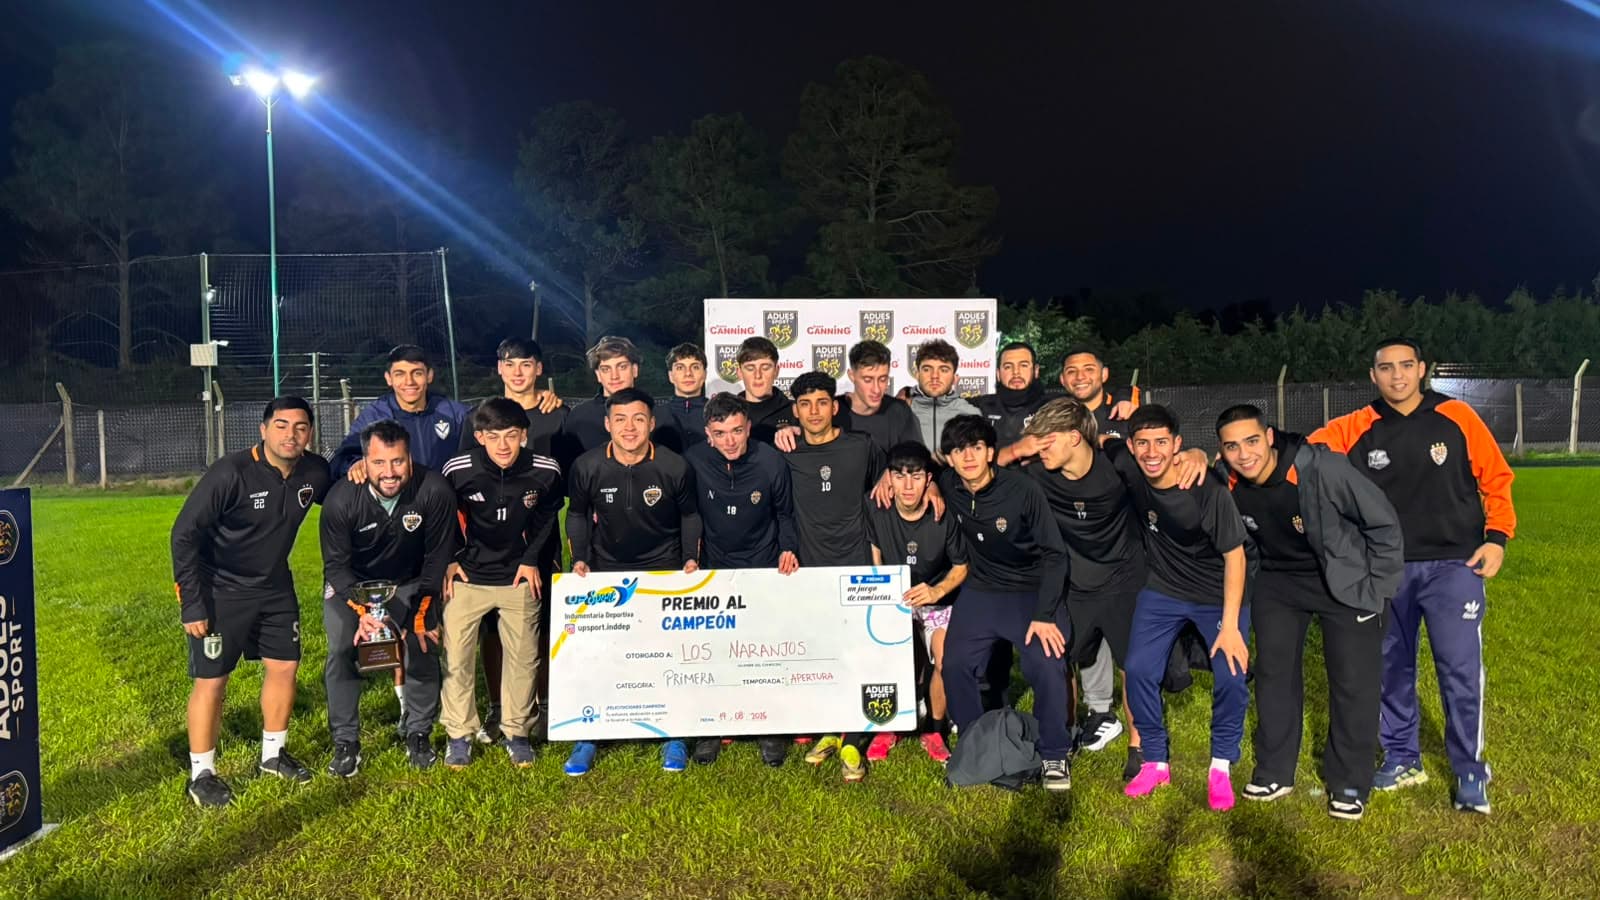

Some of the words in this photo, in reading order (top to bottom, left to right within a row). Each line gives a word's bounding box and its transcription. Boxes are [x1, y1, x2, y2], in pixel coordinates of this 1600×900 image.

[958, 378, 985, 386] ADUES
[821, 482, 831, 492] 10
[254, 498, 265, 509] 22
[496, 508, 507, 521] 11
[1077, 511, 1087, 520] 17
[661, 596, 719, 611] PREMIO
[726, 595, 747, 609] AL
[661, 611, 736, 631] CAMPEÓN
[577, 622, 631, 632] upsport.inddep
[681, 642, 712, 661] LOS
[728, 640, 807, 659] NARANJOS
[9, 621, 25, 713] SPORT
[791, 672, 834, 684] APERTURA
[865, 685, 895, 694] ADUES
